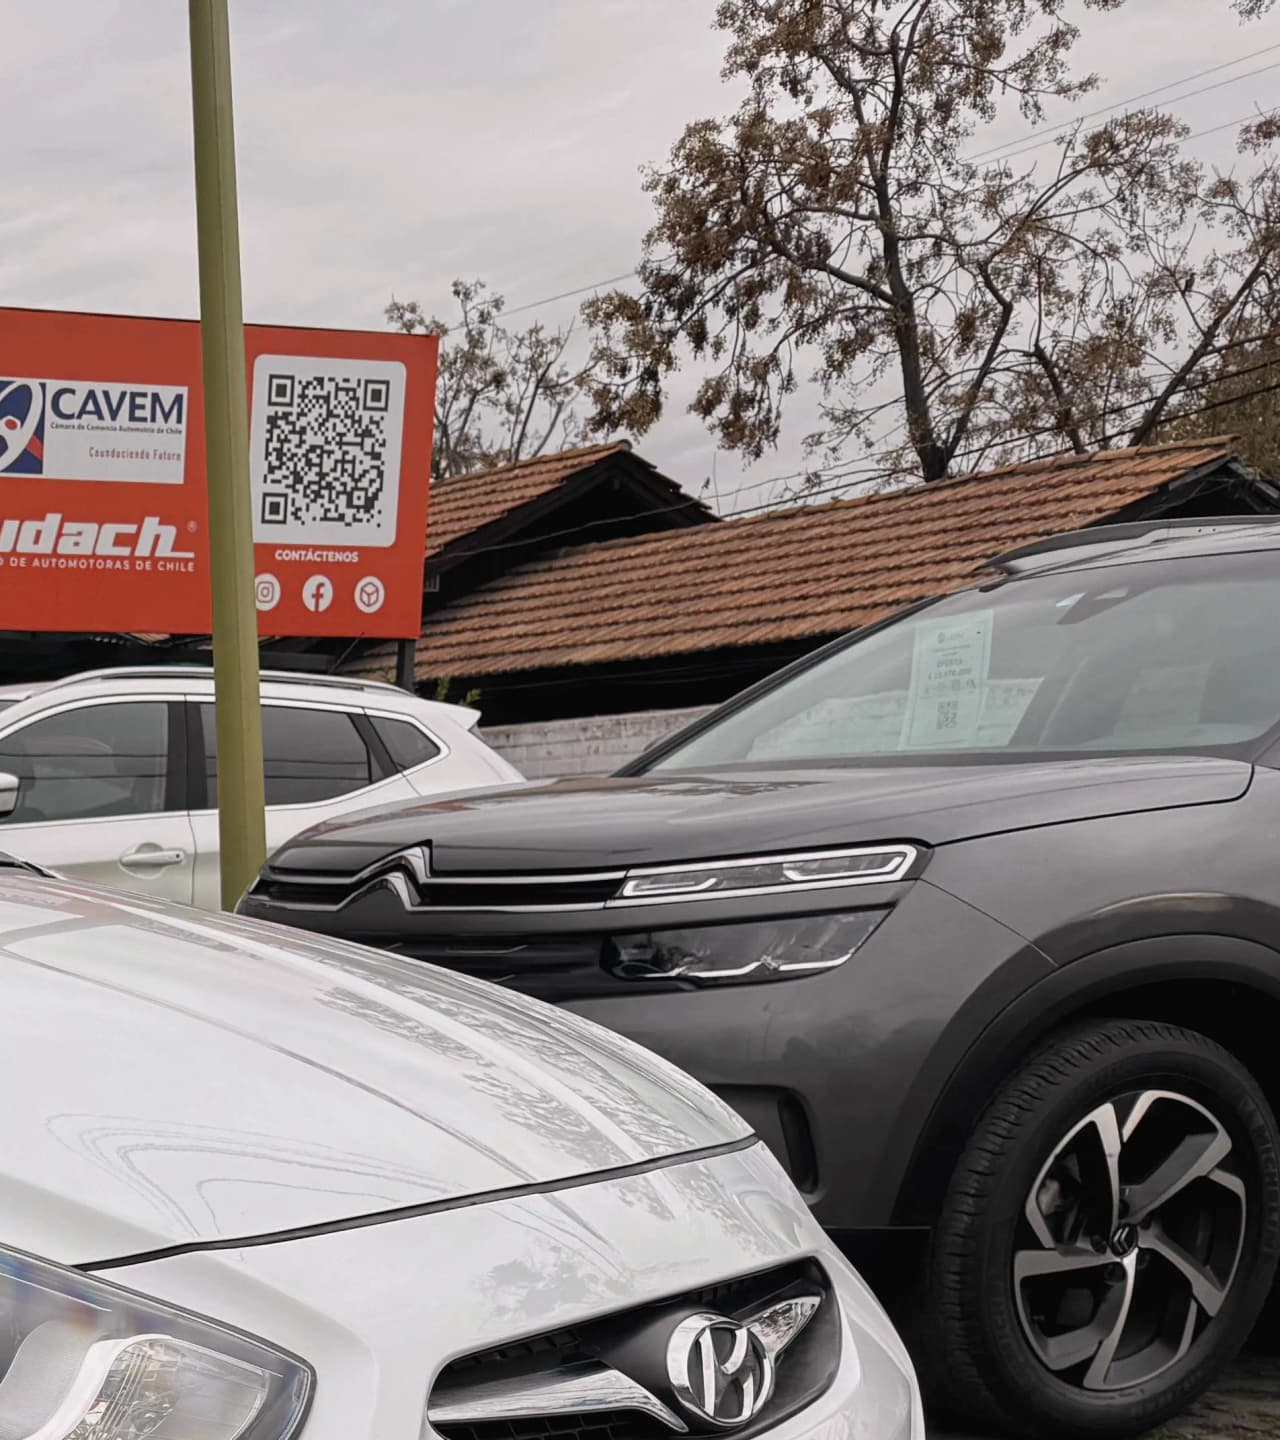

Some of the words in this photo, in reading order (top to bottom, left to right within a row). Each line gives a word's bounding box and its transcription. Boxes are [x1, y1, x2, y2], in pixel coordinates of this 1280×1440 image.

[50, 387, 184, 425] CAVEM
[273, 547, 359, 563] CONTÁCTENOS
[9, 556, 27, 568] DE
[32, 556, 130, 571] AUTOMOTORAS
[135, 559, 154, 571] DE
[157, 561, 196, 572] CHILE
